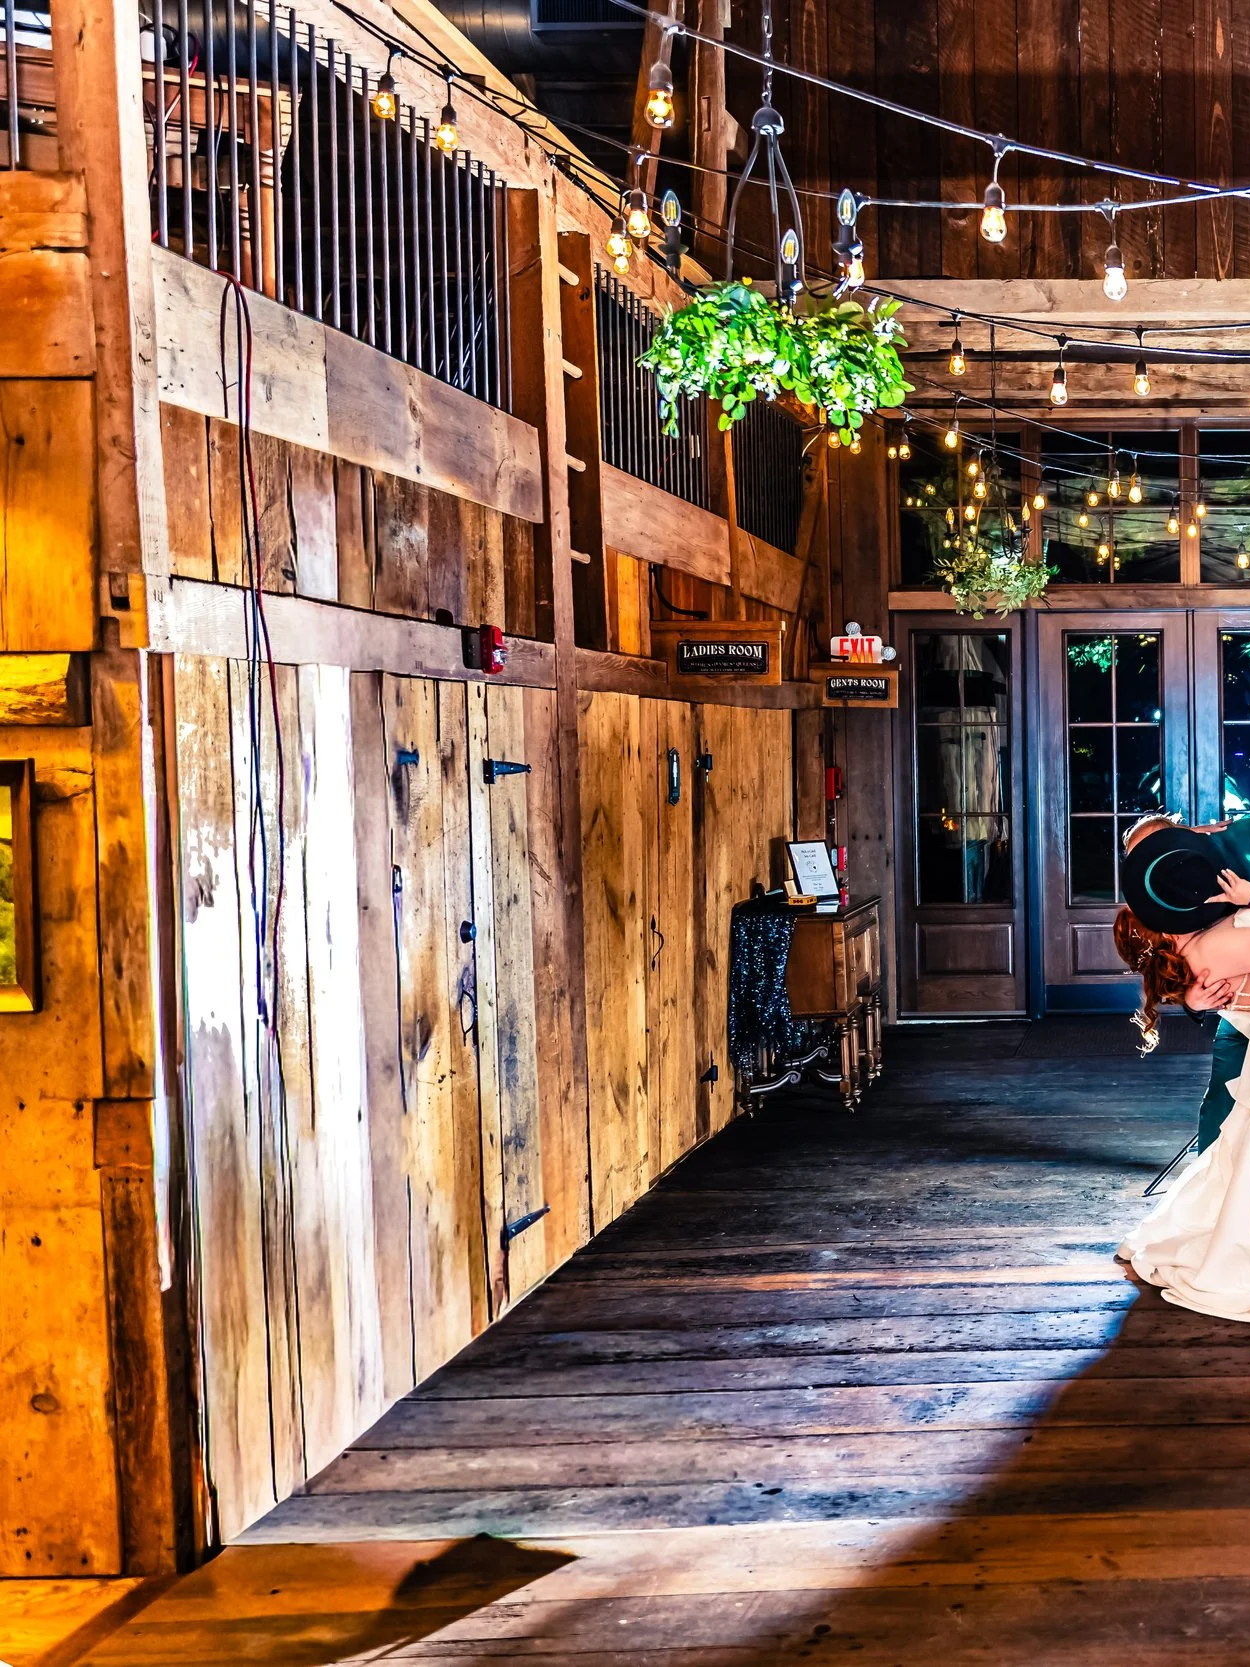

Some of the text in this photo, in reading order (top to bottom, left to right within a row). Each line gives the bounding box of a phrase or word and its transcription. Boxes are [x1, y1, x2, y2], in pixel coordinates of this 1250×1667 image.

[683, 645, 763, 659] LADIES ROOM
[839, 638, 875, 664] EXIT
[830, 679, 886, 690] GENTS ROOM
